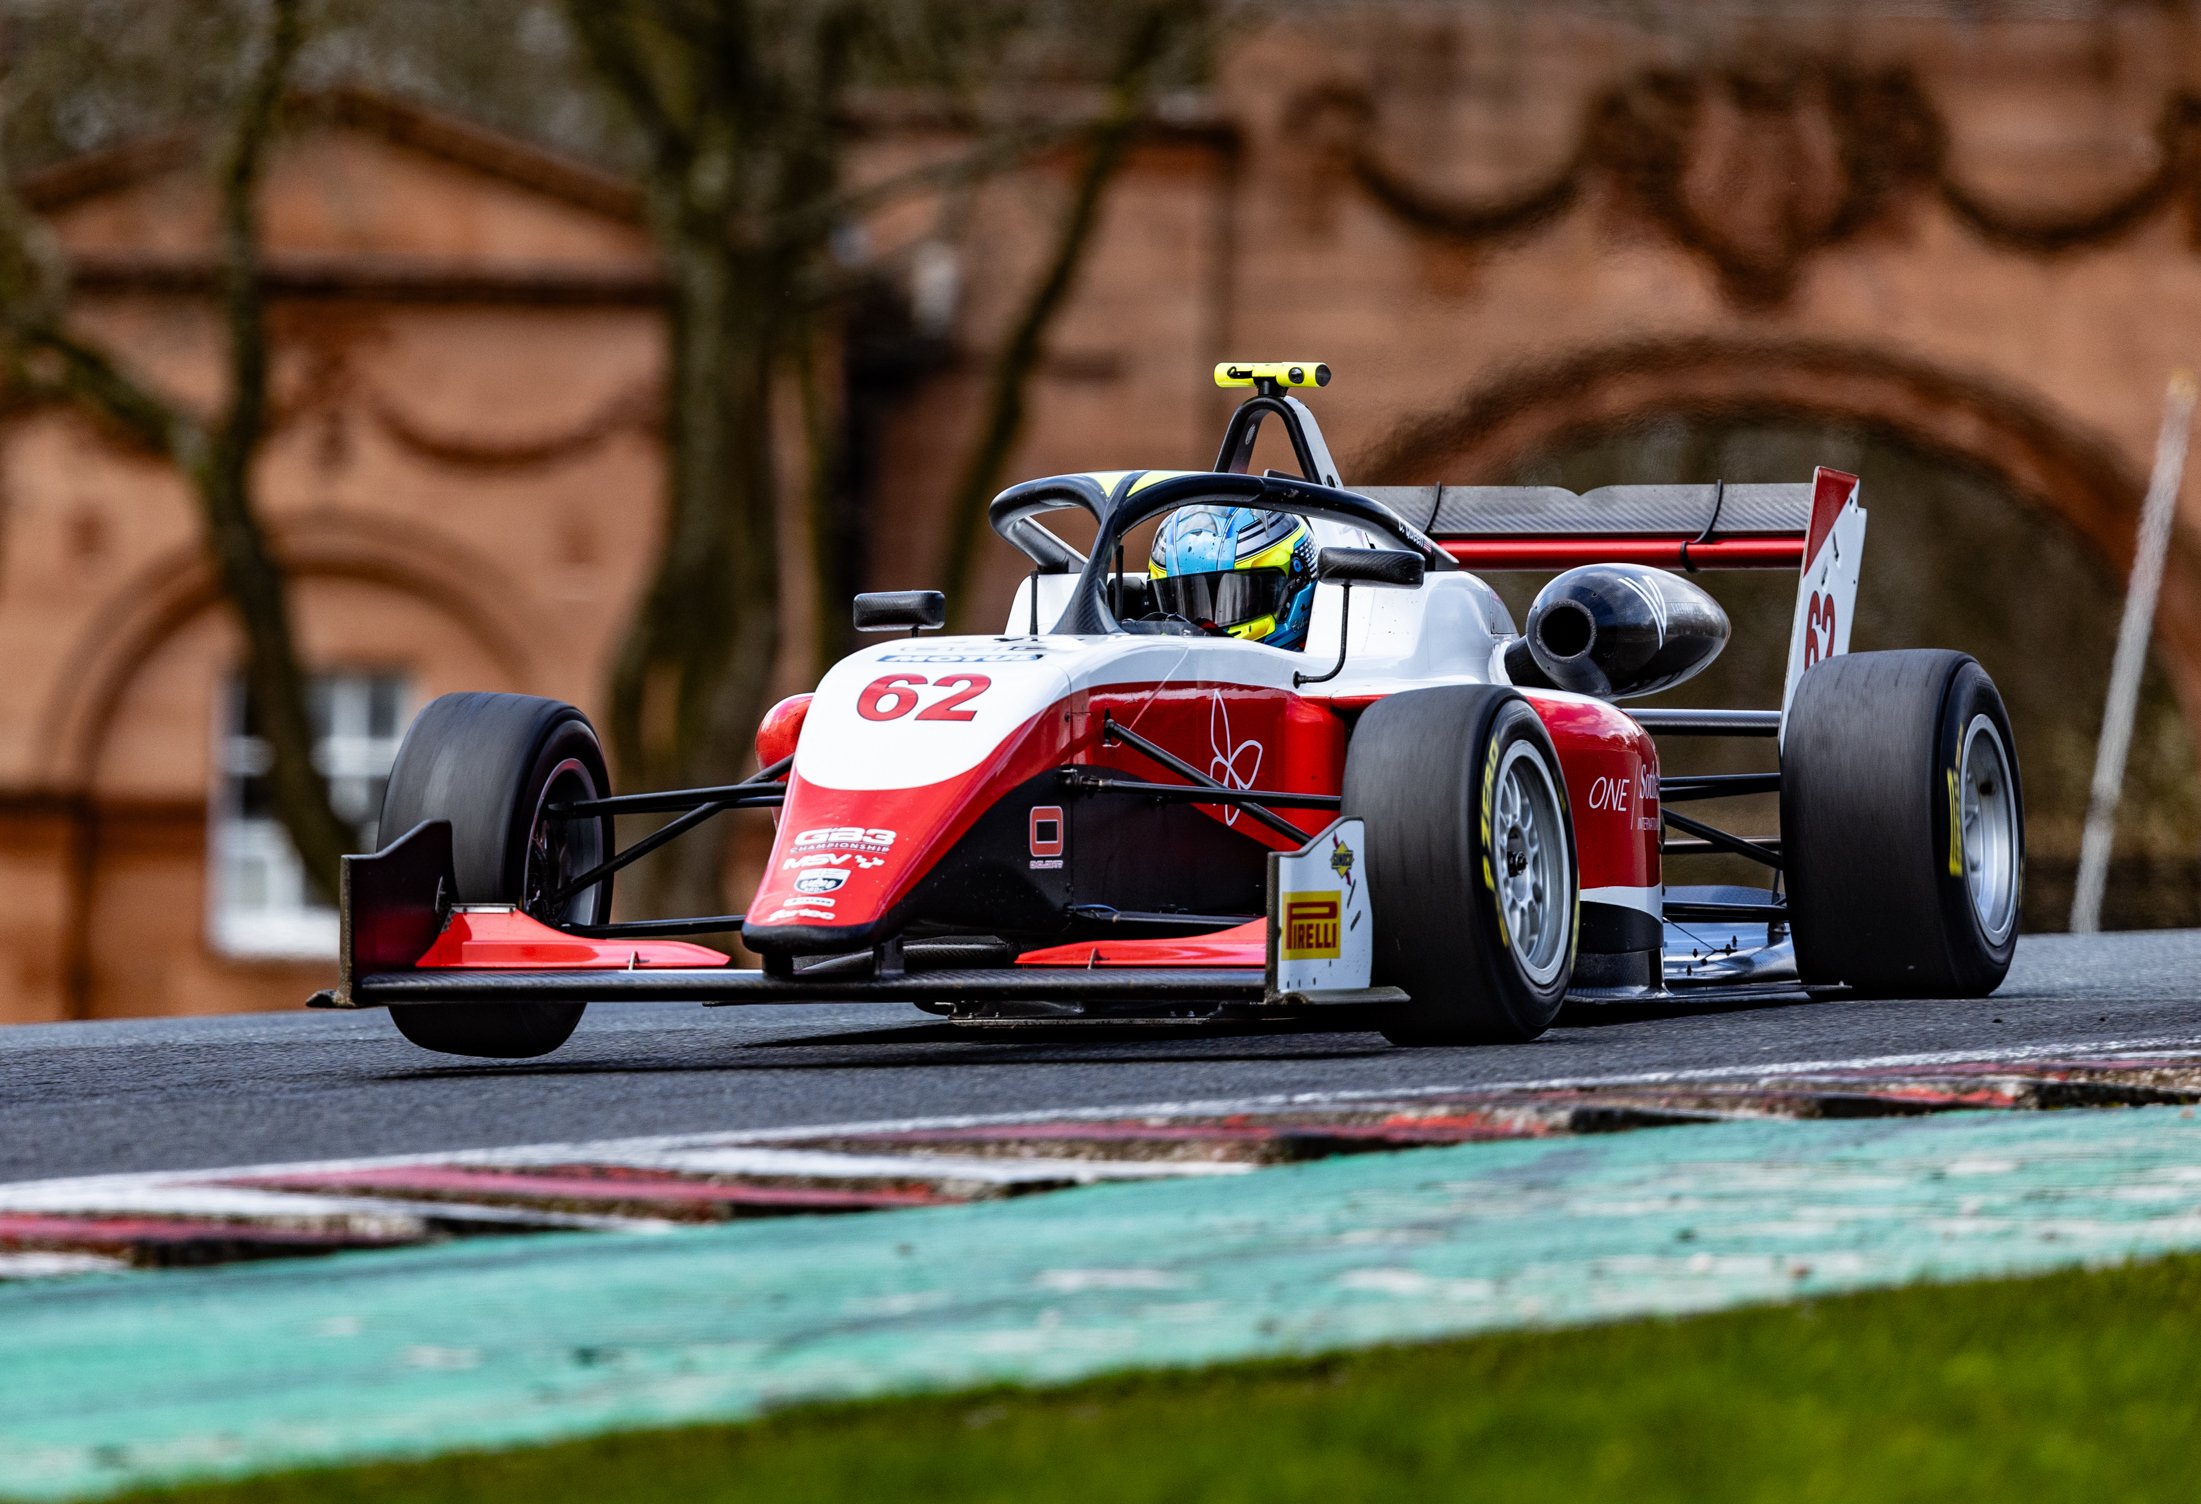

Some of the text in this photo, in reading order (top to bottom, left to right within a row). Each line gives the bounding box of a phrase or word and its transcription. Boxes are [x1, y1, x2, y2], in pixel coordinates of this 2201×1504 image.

[1804, 589, 1835, 671] 62
[856, 673, 992, 721] 62
[1588, 776, 1630, 811] ONE
[790, 842, 890, 854] CHAMPIONSHIP
[795, 826, 897, 846] GB3
[782, 853, 852, 871] MSV
[1286, 901, 1338, 950] PIRELLI
